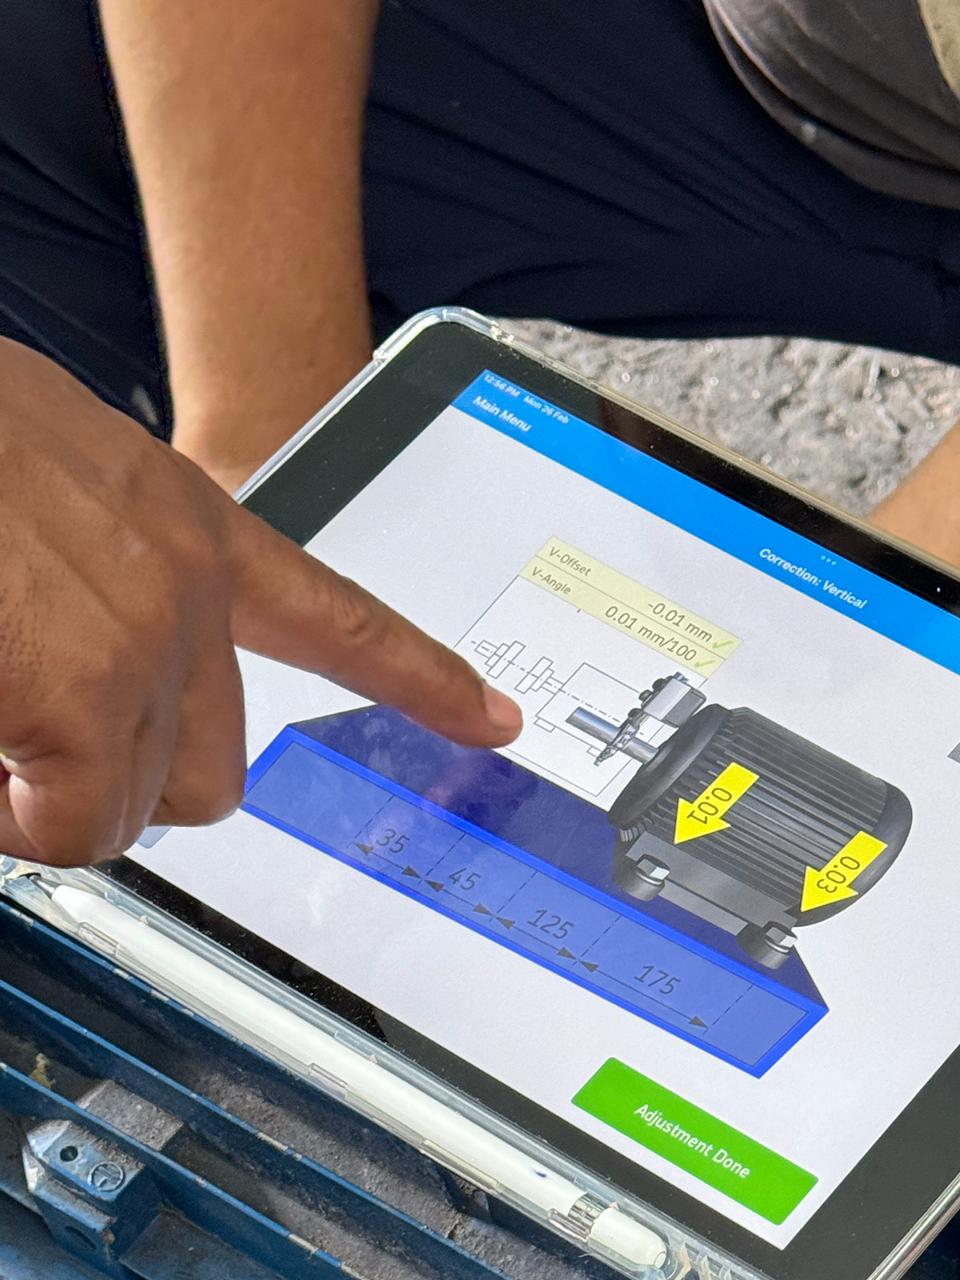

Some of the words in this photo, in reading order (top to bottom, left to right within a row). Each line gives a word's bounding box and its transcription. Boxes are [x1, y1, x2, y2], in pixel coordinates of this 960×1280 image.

[505, 384, 521, 398] PM
[473, 396, 500, 416] Main
[499, 409, 532, 432] Menu
[523, 395, 542, 410] Mon
[541, 404, 555, 416] 26
[552, 411, 570, 425] Feb
[549, 546, 592, 577] V-Offset
[648, 602, 686, 627] -0.01
[685, 623, 713, 643] mm
[759, 548, 822, 586] Correction:
[822, 580, 868, 609] Vertical
[531, 566, 572, 595] V-Angle
[605, 606, 637, 630] 0.01
[637, 625, 697, 662] mm/100
[687, 787, 732, 824] 0.01
[376, 828, 410, 854] 35
[448, 867, 481, 891] 45
[816, 856, 860, 893] 0.03
[527, 909, 574, 940] 125
[633, 965, 681, 995] 175
[634, 1104, 714, 1156] Adjustment
[712, 1149, 751, 1178] Done
